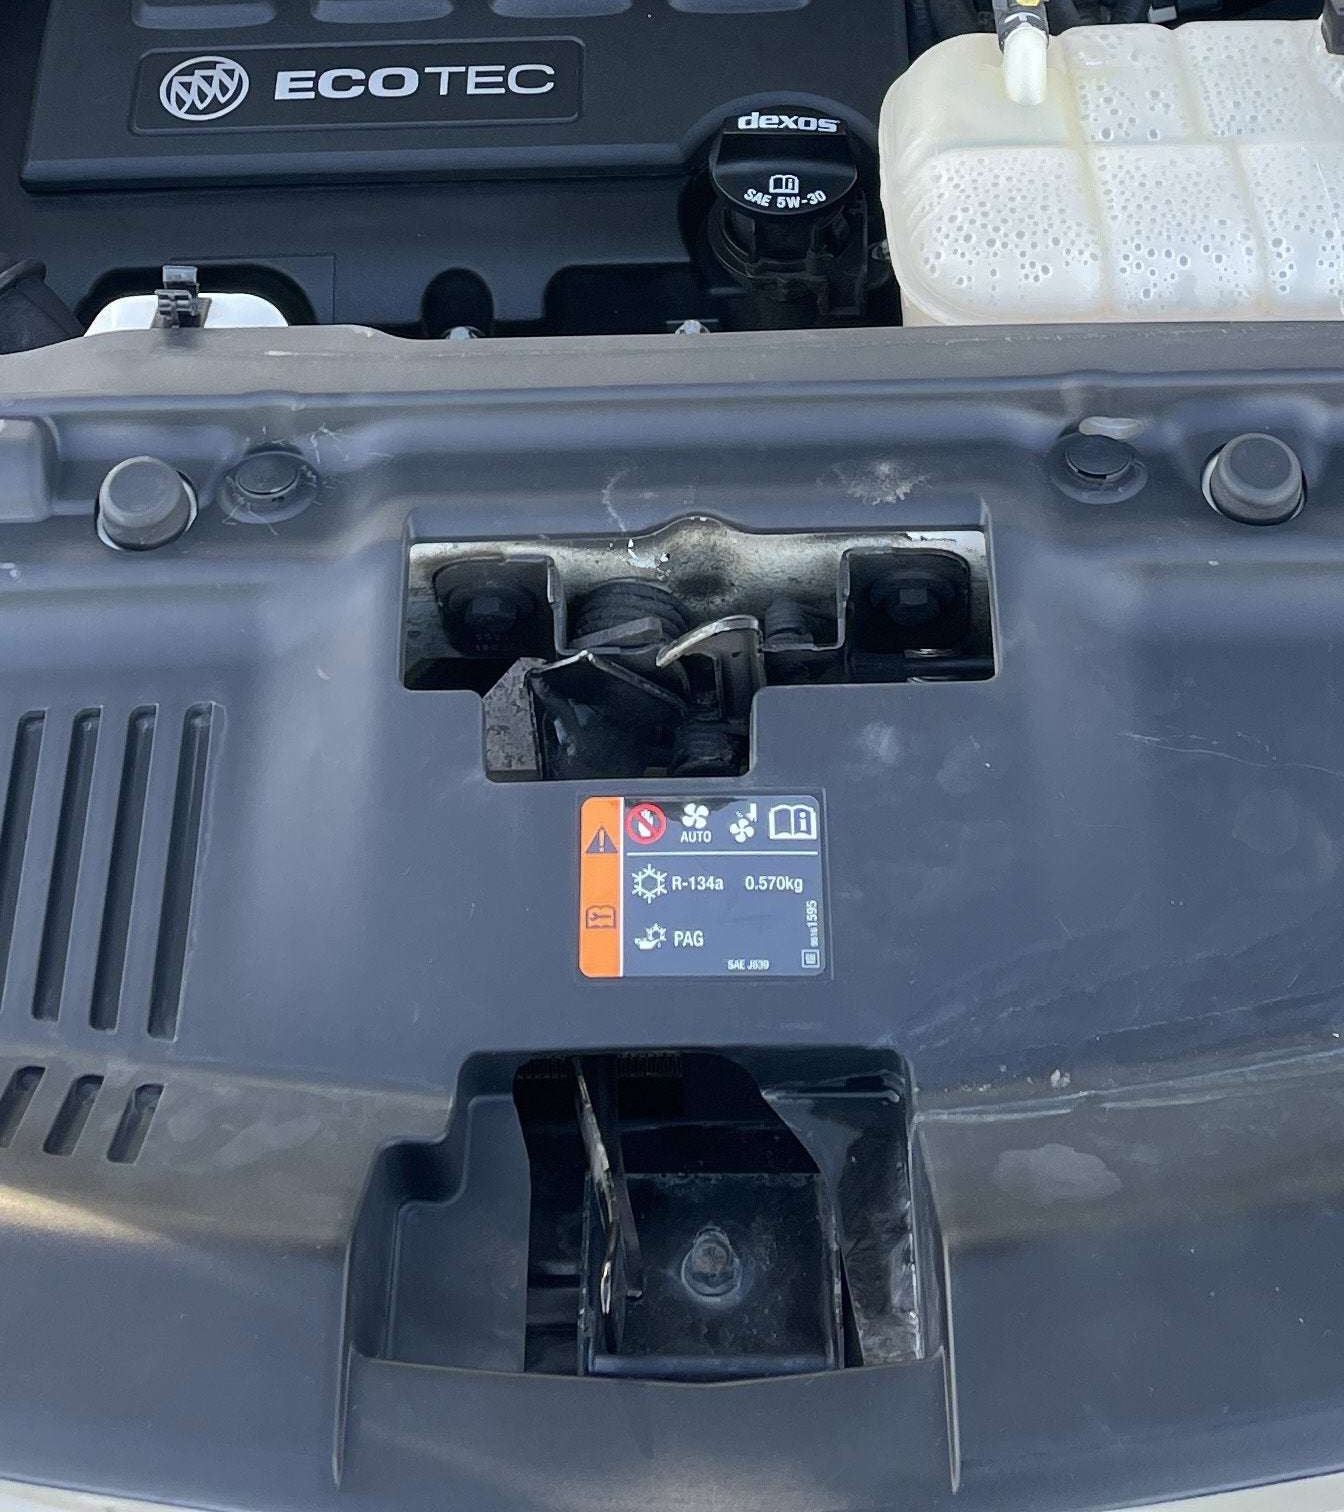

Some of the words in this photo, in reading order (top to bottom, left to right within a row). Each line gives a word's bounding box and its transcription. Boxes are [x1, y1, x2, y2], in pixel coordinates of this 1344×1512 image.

[274, 63, 556, 101] ECOTEC
[737, 111, 841, 133] dexos
[743, 188, 772, 207] SAE
[776, 190, 827, 209] 5W-30
[680, 830, 712, 843] AUTO
[671, 875, 724, 891] R-134a
[744, 875, 804, 894] 0.570kg
[673, 930, 704, 948] PAG
